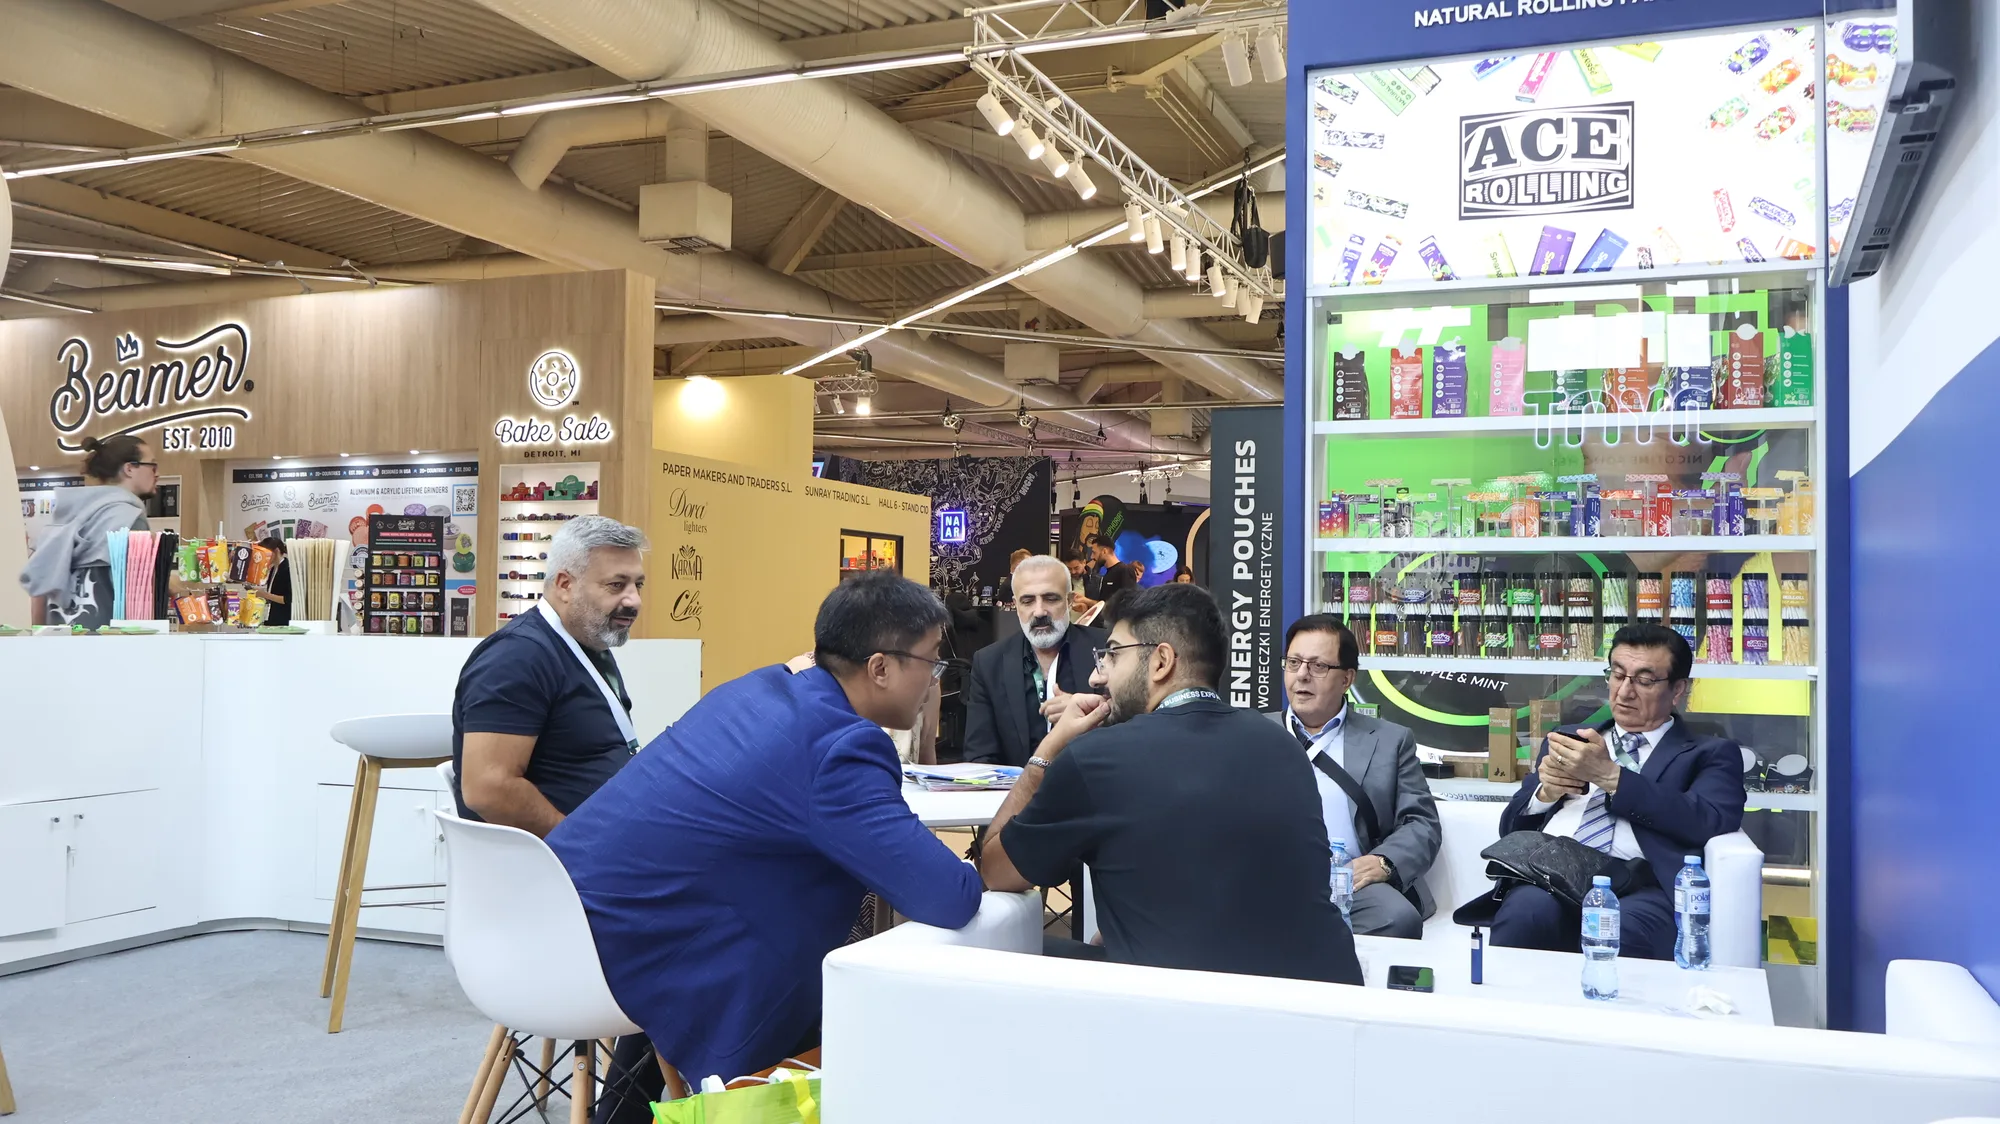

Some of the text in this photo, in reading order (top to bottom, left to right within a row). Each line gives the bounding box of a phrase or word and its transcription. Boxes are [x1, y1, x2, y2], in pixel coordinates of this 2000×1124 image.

[1414, 8, 1512, 28] NATURAL
[1467, 116, 1617, 173] ACE
[1465, 172, 1627, 204] ROLLING
[50, 323, 249, 432] Beamer
[163, 426, 232, 450] EST. 2010
[495, 416, 611, 443] Bake Sale
[524, 449, 581, 458] DETROIT, MI
[662, 462, 793, 493] PAPER MAKERS AND TRADERS S.L.
[350, 487, 376, 495] ALUMINUM
[380, 487, 401, 495] ACRYLIC
[401, 486, 423, 495] LIFETIME
[423, 486, 449, 494] GRINDERS
[805, 485, 871, 506] SUNRAY TRADING S.L.
[669, 487, 706, 520] Dora
[878, 497, 893, 509] HALL
[893, 500, 898, 510] 6
[901, 501, 920, 513] STAND
[919, 504, 929, 515] C10
[683, 520, 708, 535] lighters
[945, 515, 960, 526] NA
[945, 526, 960, 538] AR
[671, 553, 703, 581] KARMA
[1230, 439, 1257, 709] ENERGY POUCHES
[671, 589, 703, 619] Chic
[1257, 511, 1274, 709] WORECZKI ENERGETYCZNE
[1457, 673, 1467, 684] &
[1470, 675, 1509, 692] MINT
[1164, 690, 1200, 707] BUSINESS
